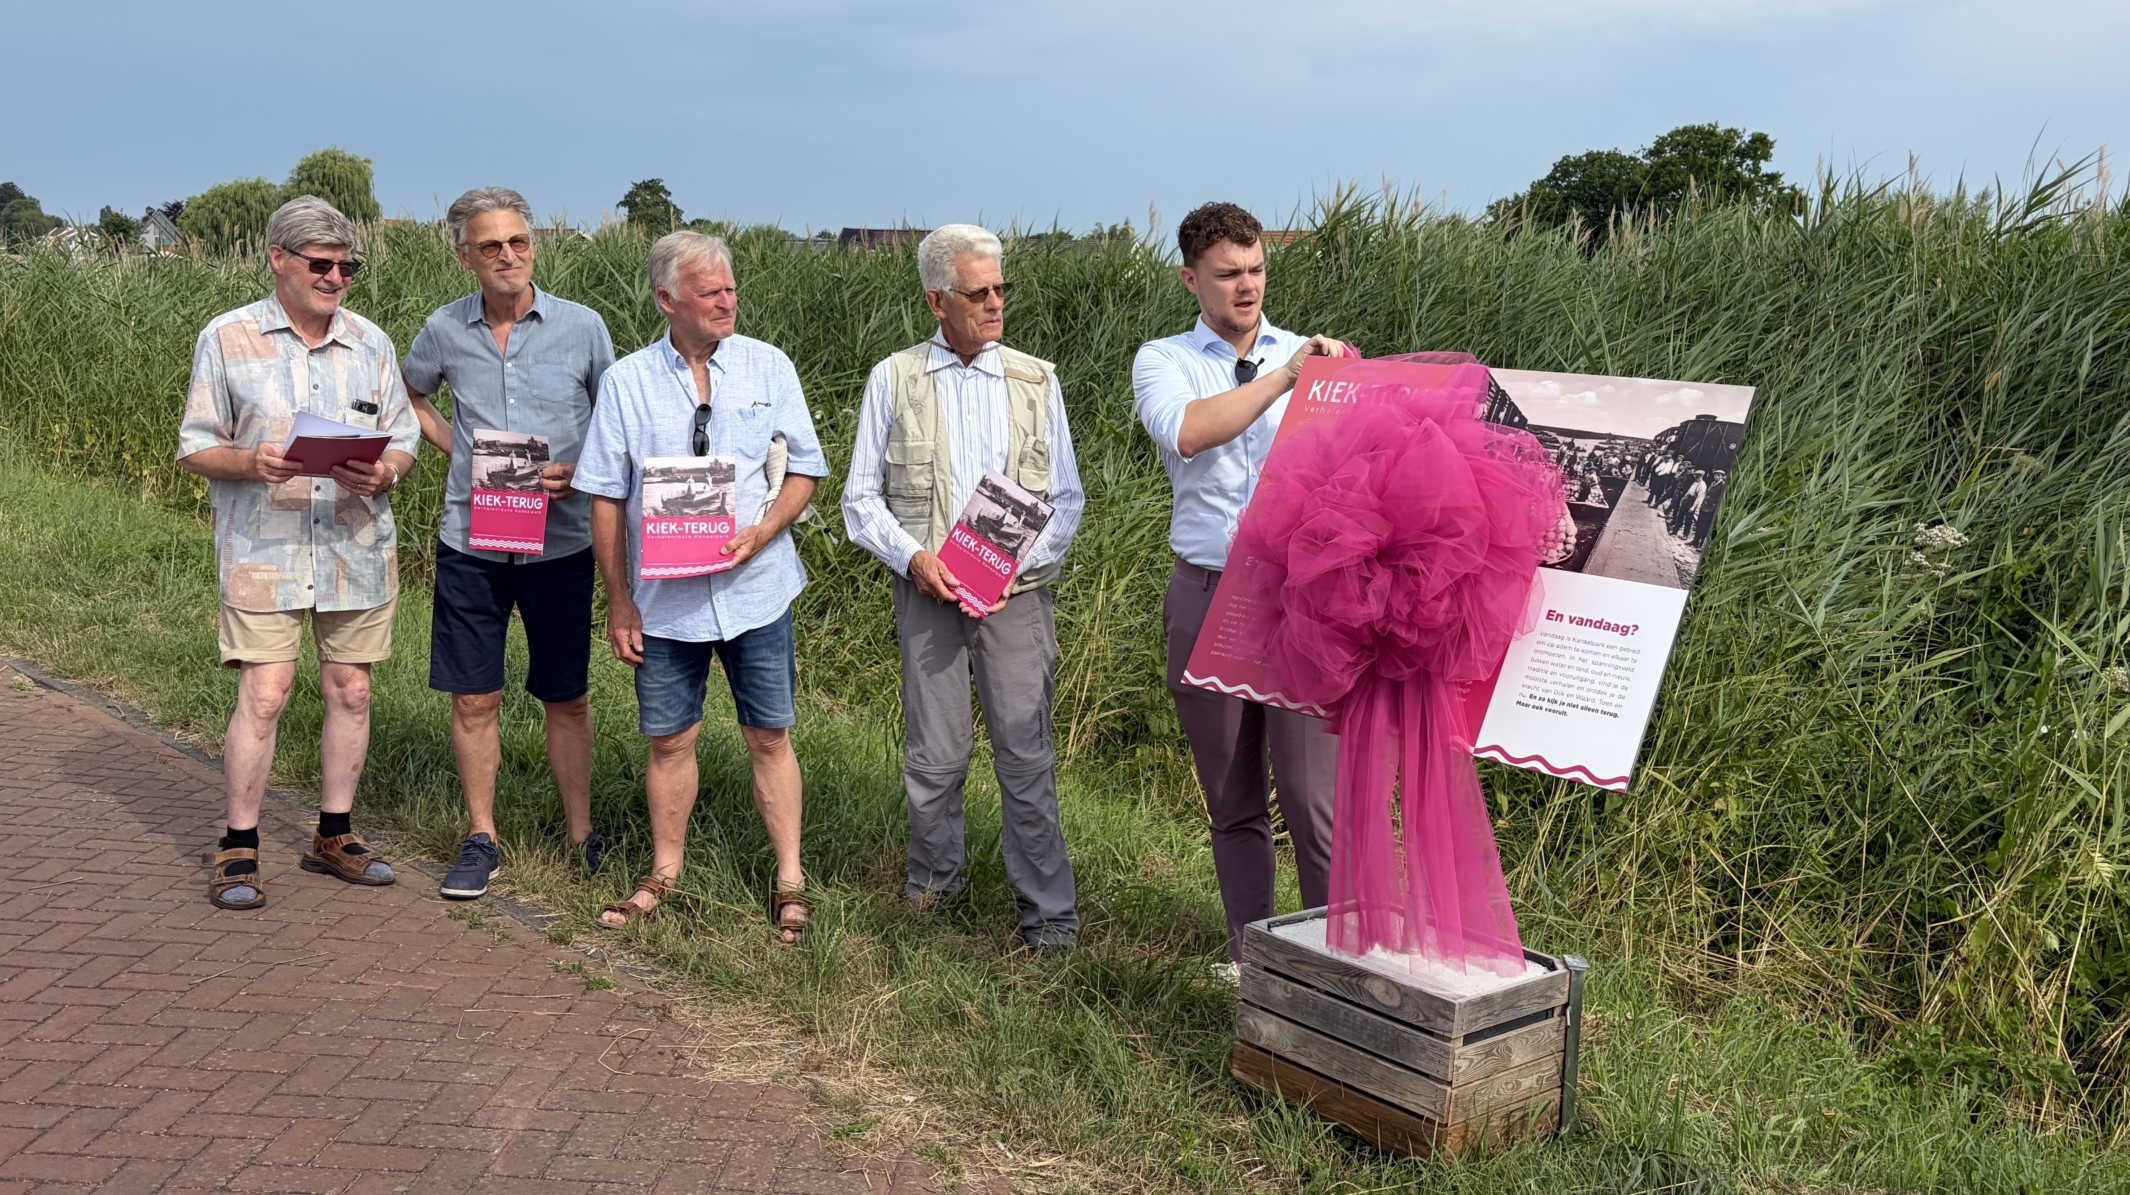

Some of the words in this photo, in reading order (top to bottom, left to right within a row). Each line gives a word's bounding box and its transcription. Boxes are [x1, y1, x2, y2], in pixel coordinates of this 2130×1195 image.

[473, 493, 543, 510] KIEK-TERUG
[646, 521, 730, 535] KIEK-TERUG
[951, 527, 1012, 575] KIEK-TERUG
[1545, 609, 1564, 623] En
[1568, 614, 1639, 637] vandaag?
[1516, 700, 1531, 708] Maar
[1580, 705, 1599, 713] alleen
